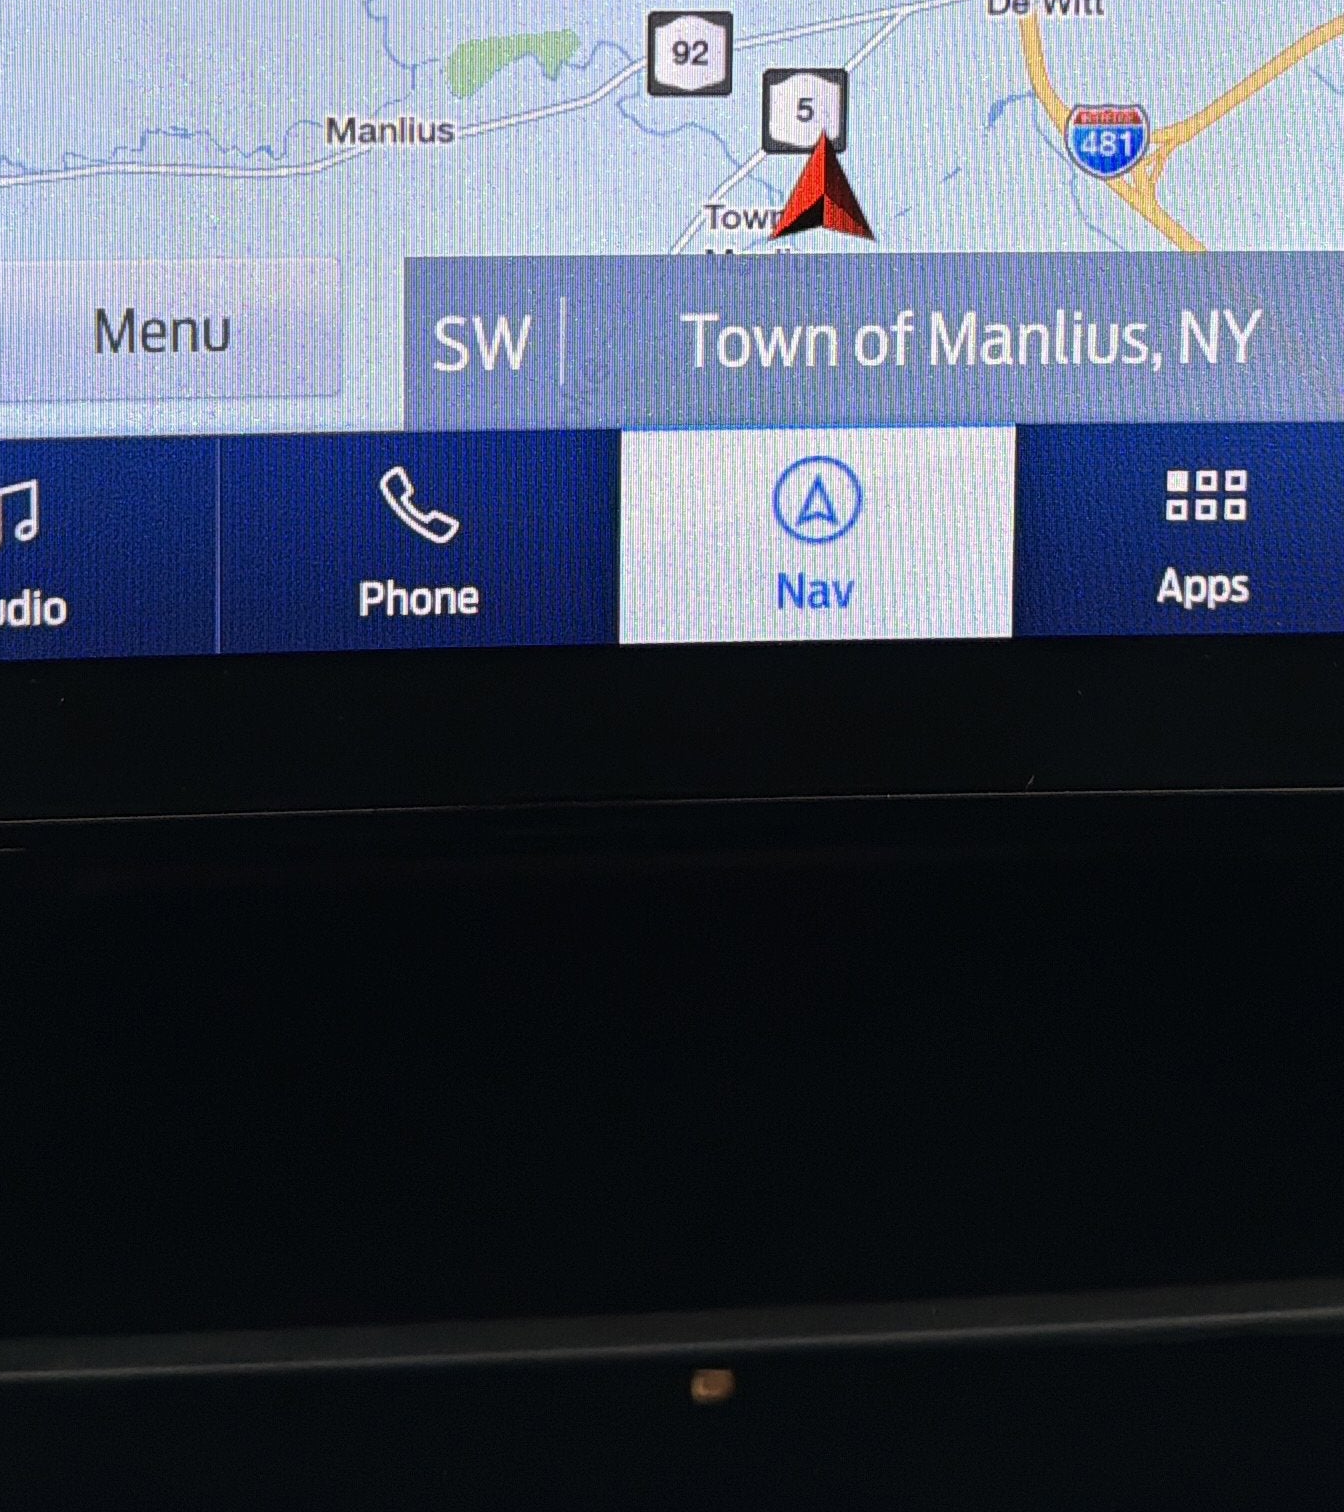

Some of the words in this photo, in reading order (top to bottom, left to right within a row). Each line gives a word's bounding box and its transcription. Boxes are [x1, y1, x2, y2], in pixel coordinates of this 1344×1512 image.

[671, 39, 709, 66] 92
[796, 97, 816, 123] 5
[326, 116, 455, 144] Manlius
[1080, 130, 1133, 158] 481
[94, 307, 231, 354] Menu
[432, 314, 532, 372] SW
[679, 312, 839, 368] Town
[854, 309, 915, 367] of
[929, 308, 1163, 373] Manlius,
[1179, 308, 1264, 364] NY
[359, 578, 480, 617] Phone
[777, 571, 855, 609] Nav
[1156, 566, 1250, 610] Apps
